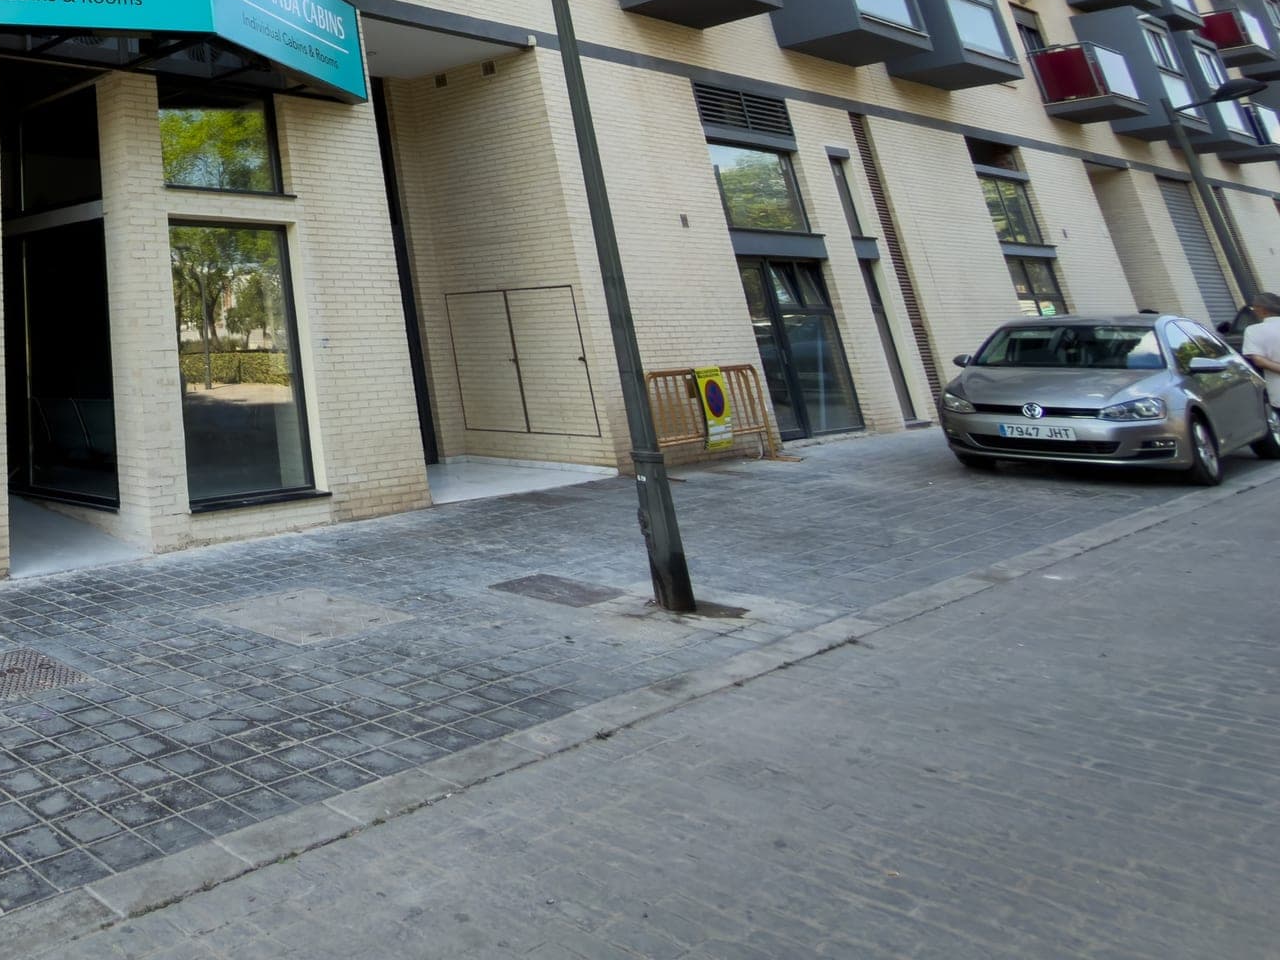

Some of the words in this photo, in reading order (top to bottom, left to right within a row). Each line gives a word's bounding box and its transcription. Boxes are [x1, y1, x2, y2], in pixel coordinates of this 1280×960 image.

[242, 10, 281, 41] Individual
[282, 32, 308, 55] Cabins
[1007, 426, 1039, 437] 7947
[1046, 427, 1070, 439] JHT
